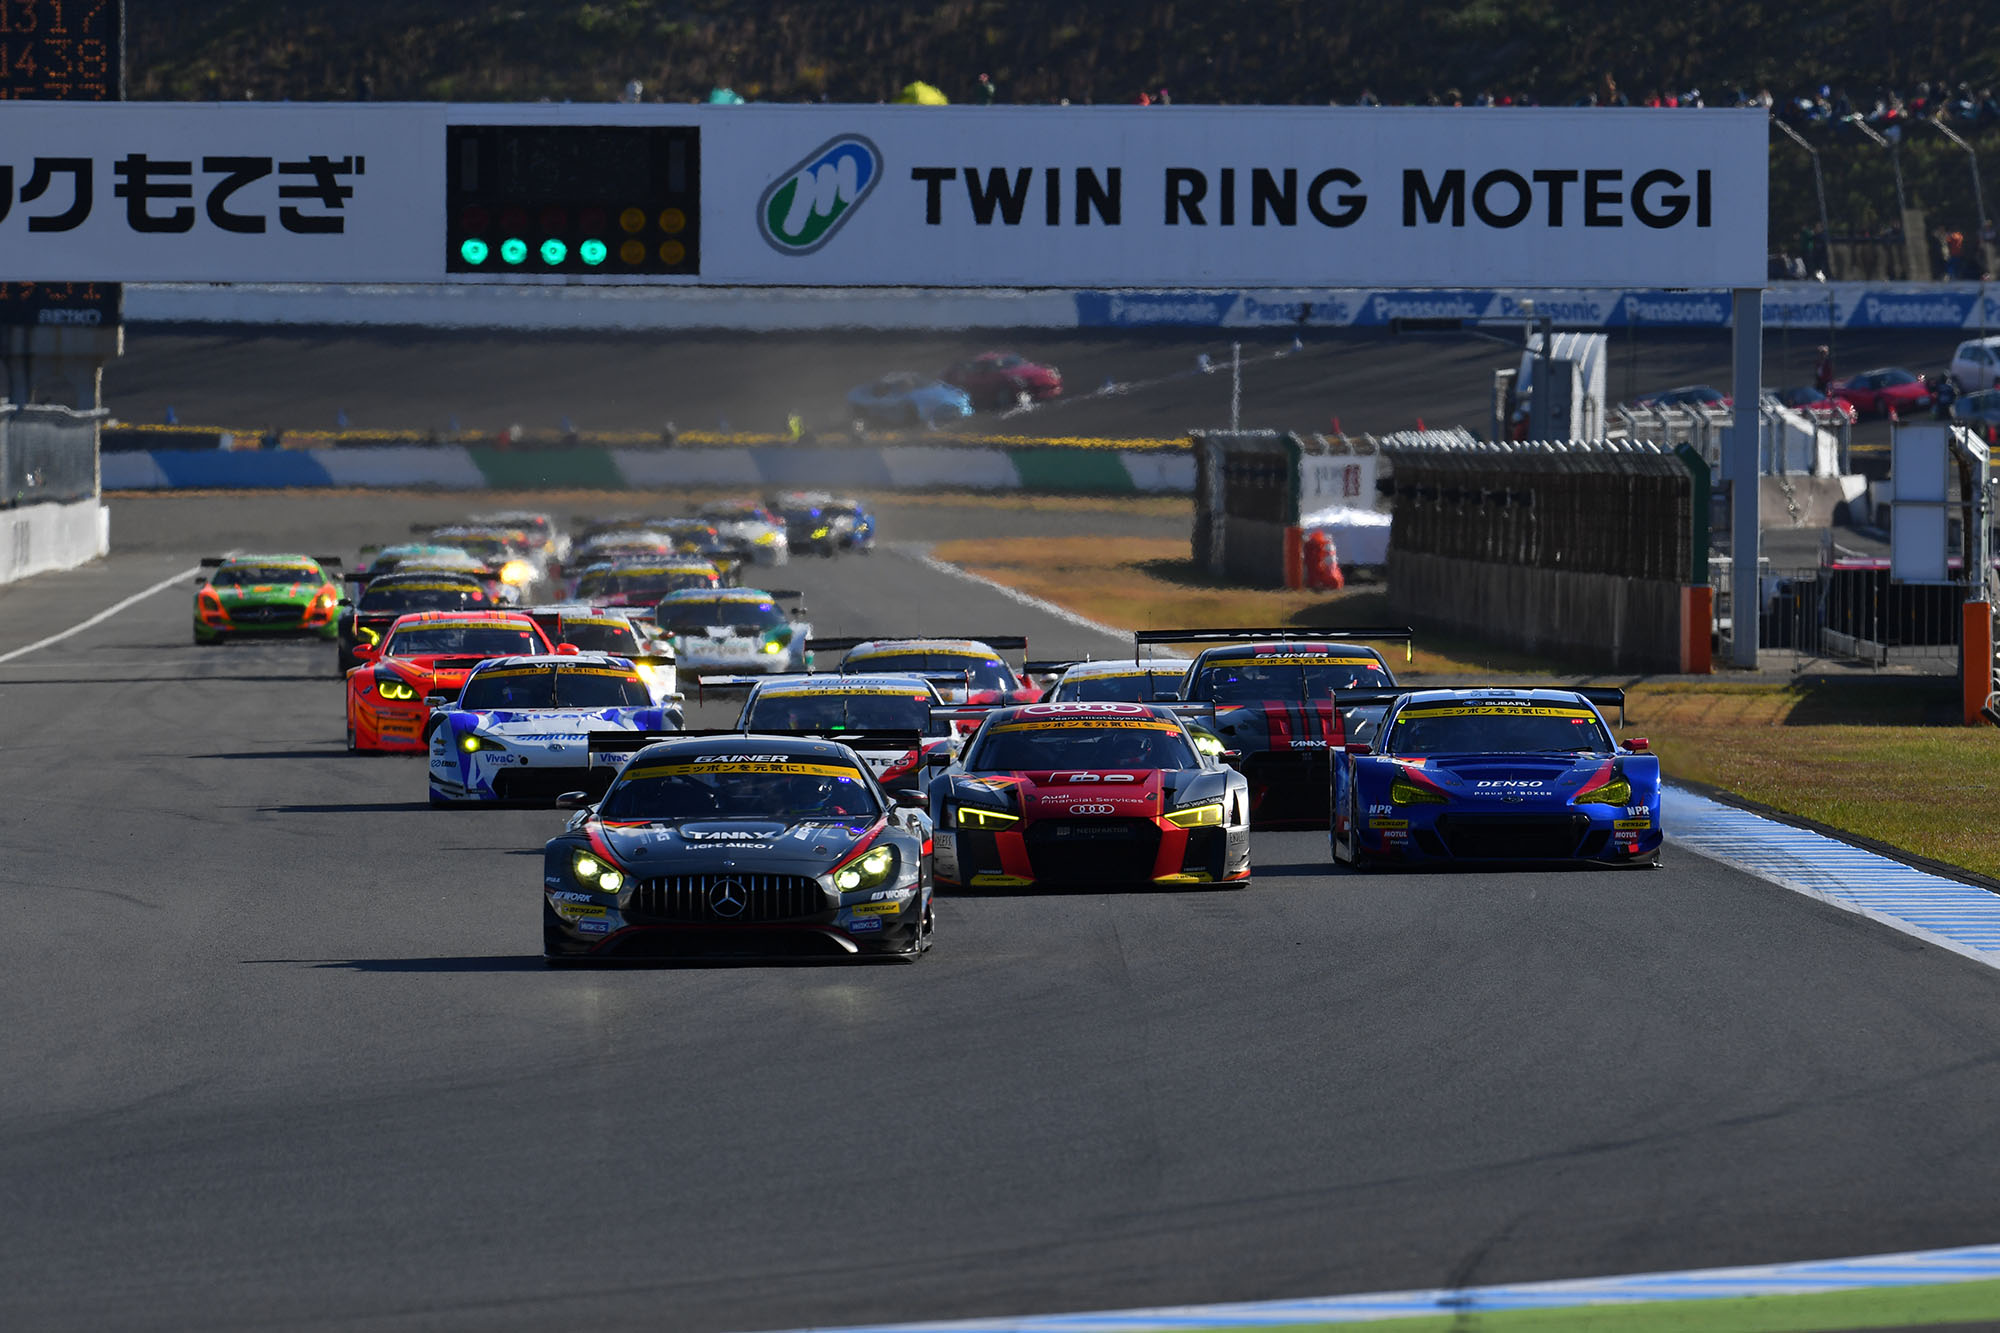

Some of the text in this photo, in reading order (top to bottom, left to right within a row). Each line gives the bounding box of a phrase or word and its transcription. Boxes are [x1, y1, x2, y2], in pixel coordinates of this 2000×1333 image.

[0, 153, 365, 234] クもてぎ
[911, 166, 1711, 229] TWIN RING MOTEGI
[1624, 297, 1724, 321] Panasonic
[1866, 298, 1962, 323] Panasonic
[485, 754, 514, 763] VivaC
[600, 753, 628, 762] VivaC
[693, 754, 789, 763] GAINER
[1368, 804, 1392, 814] NPR
[1627, 806, 1650, 815] NPR
[688, 830, 777, 840] TANAX
[563, 891, 592, 902] WORK
[885, 888, 911, 899] WORK
[569, 906, 603, 914] DUNLOP
[864, 904, 897, 912] DUNLOP
